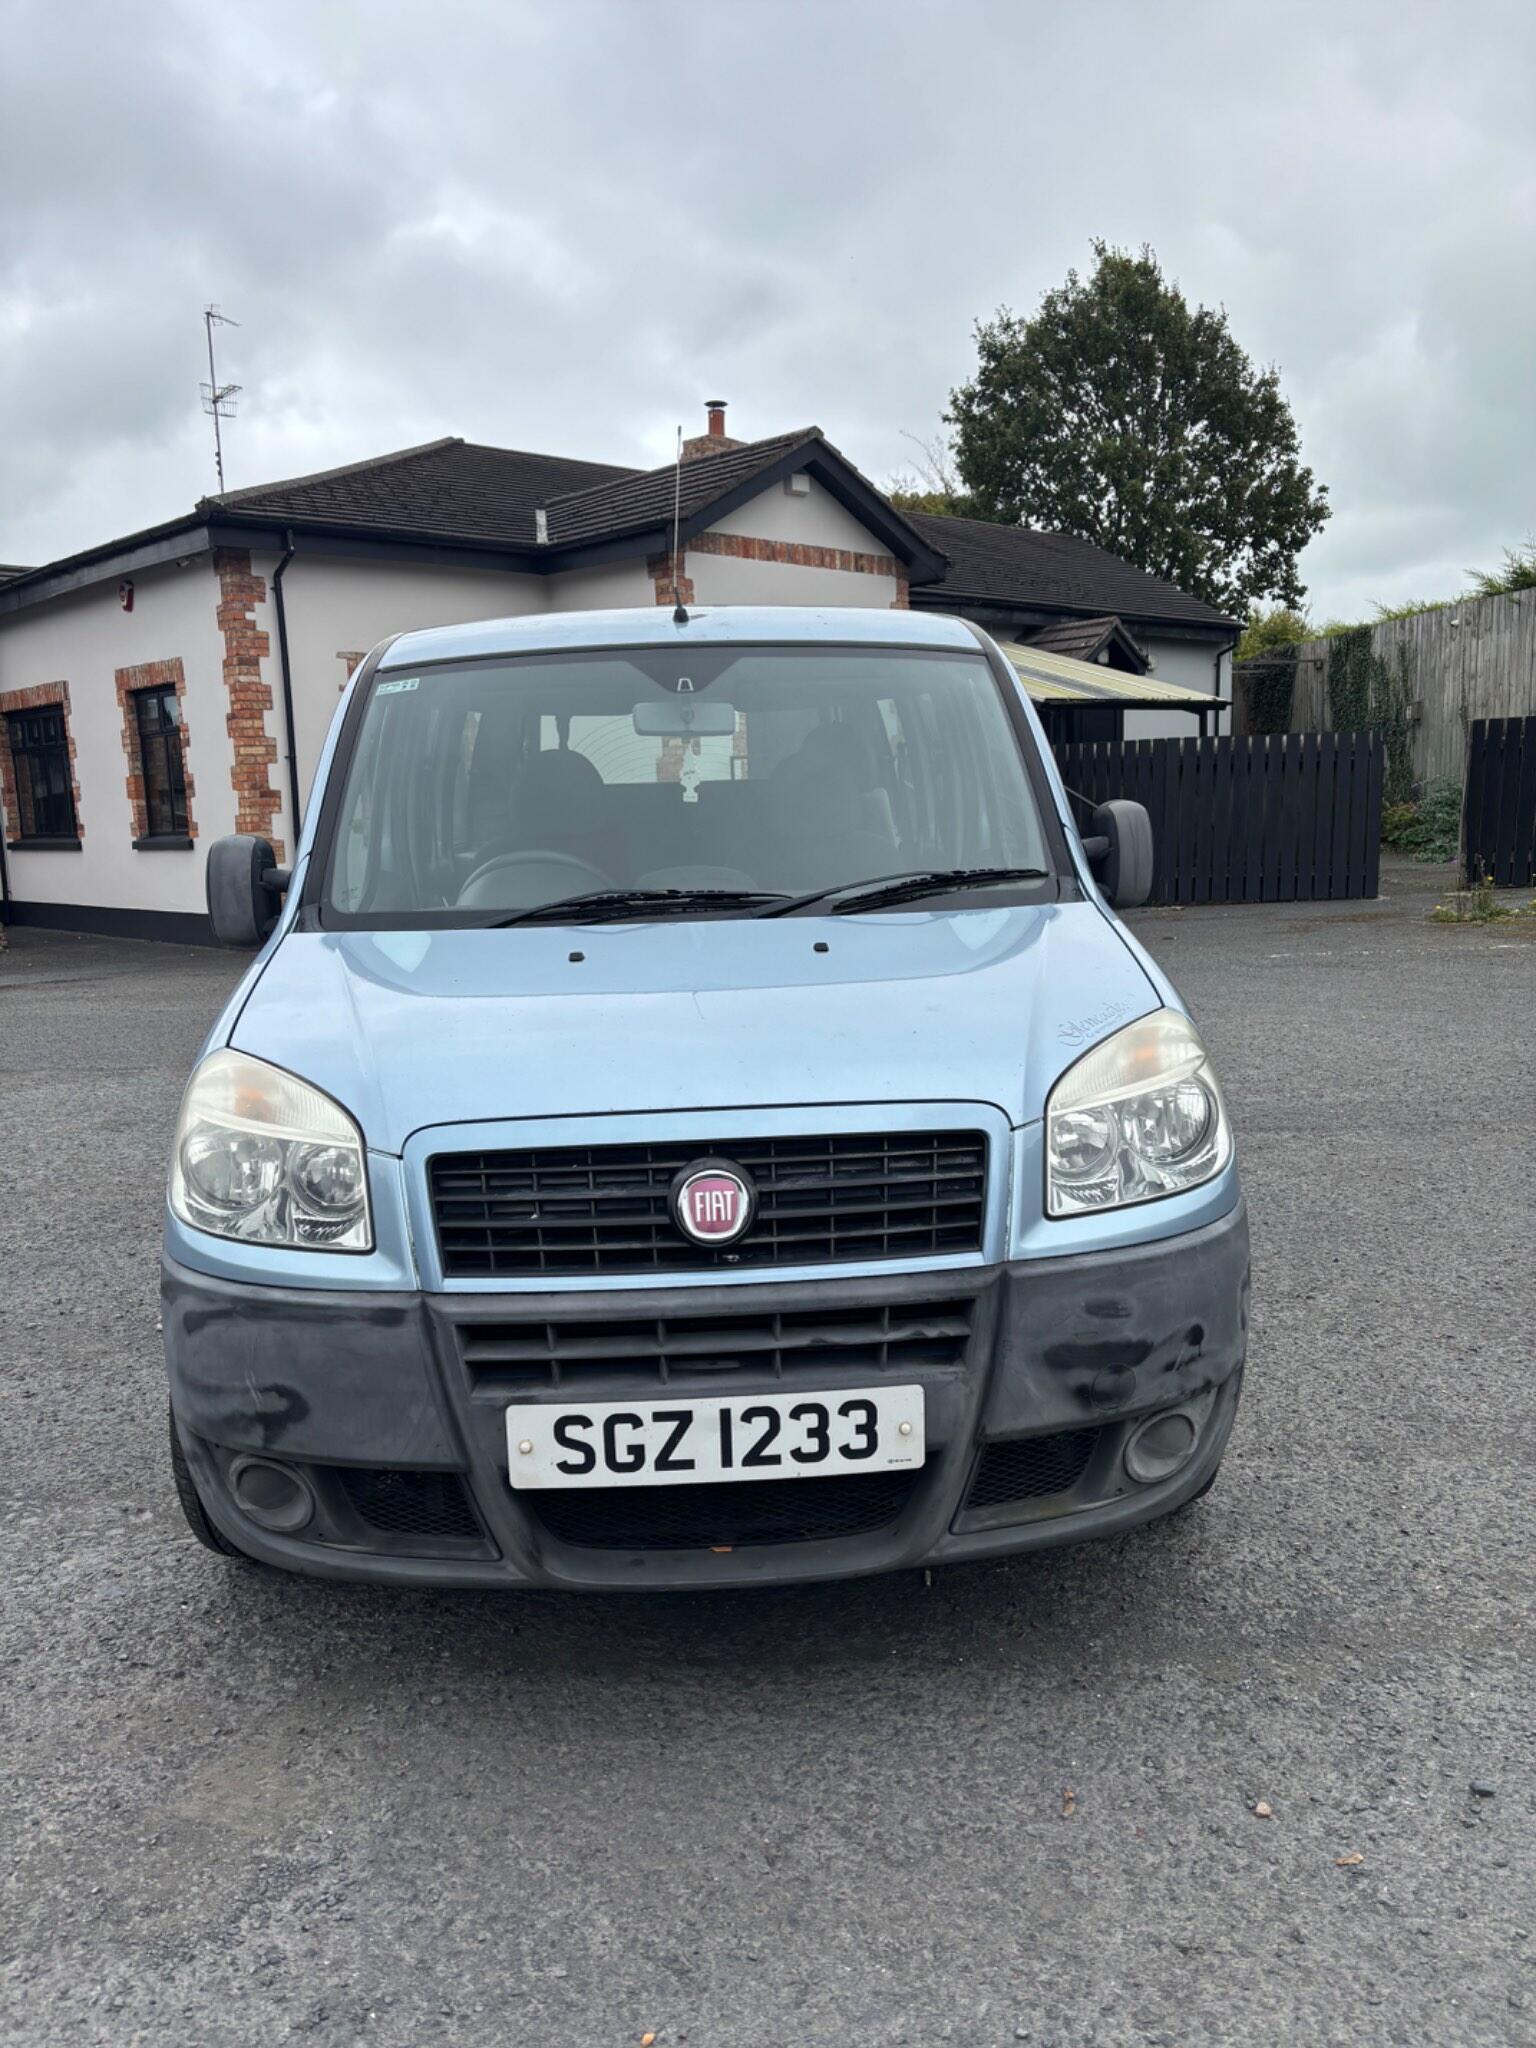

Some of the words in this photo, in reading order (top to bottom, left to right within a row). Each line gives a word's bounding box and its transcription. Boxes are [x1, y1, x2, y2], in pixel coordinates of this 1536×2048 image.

[695, 1190, 735, 1222] FIAT
[553, 1409, 695, 1475] SGZ
[719, 1399, 878, 1469] 1233
